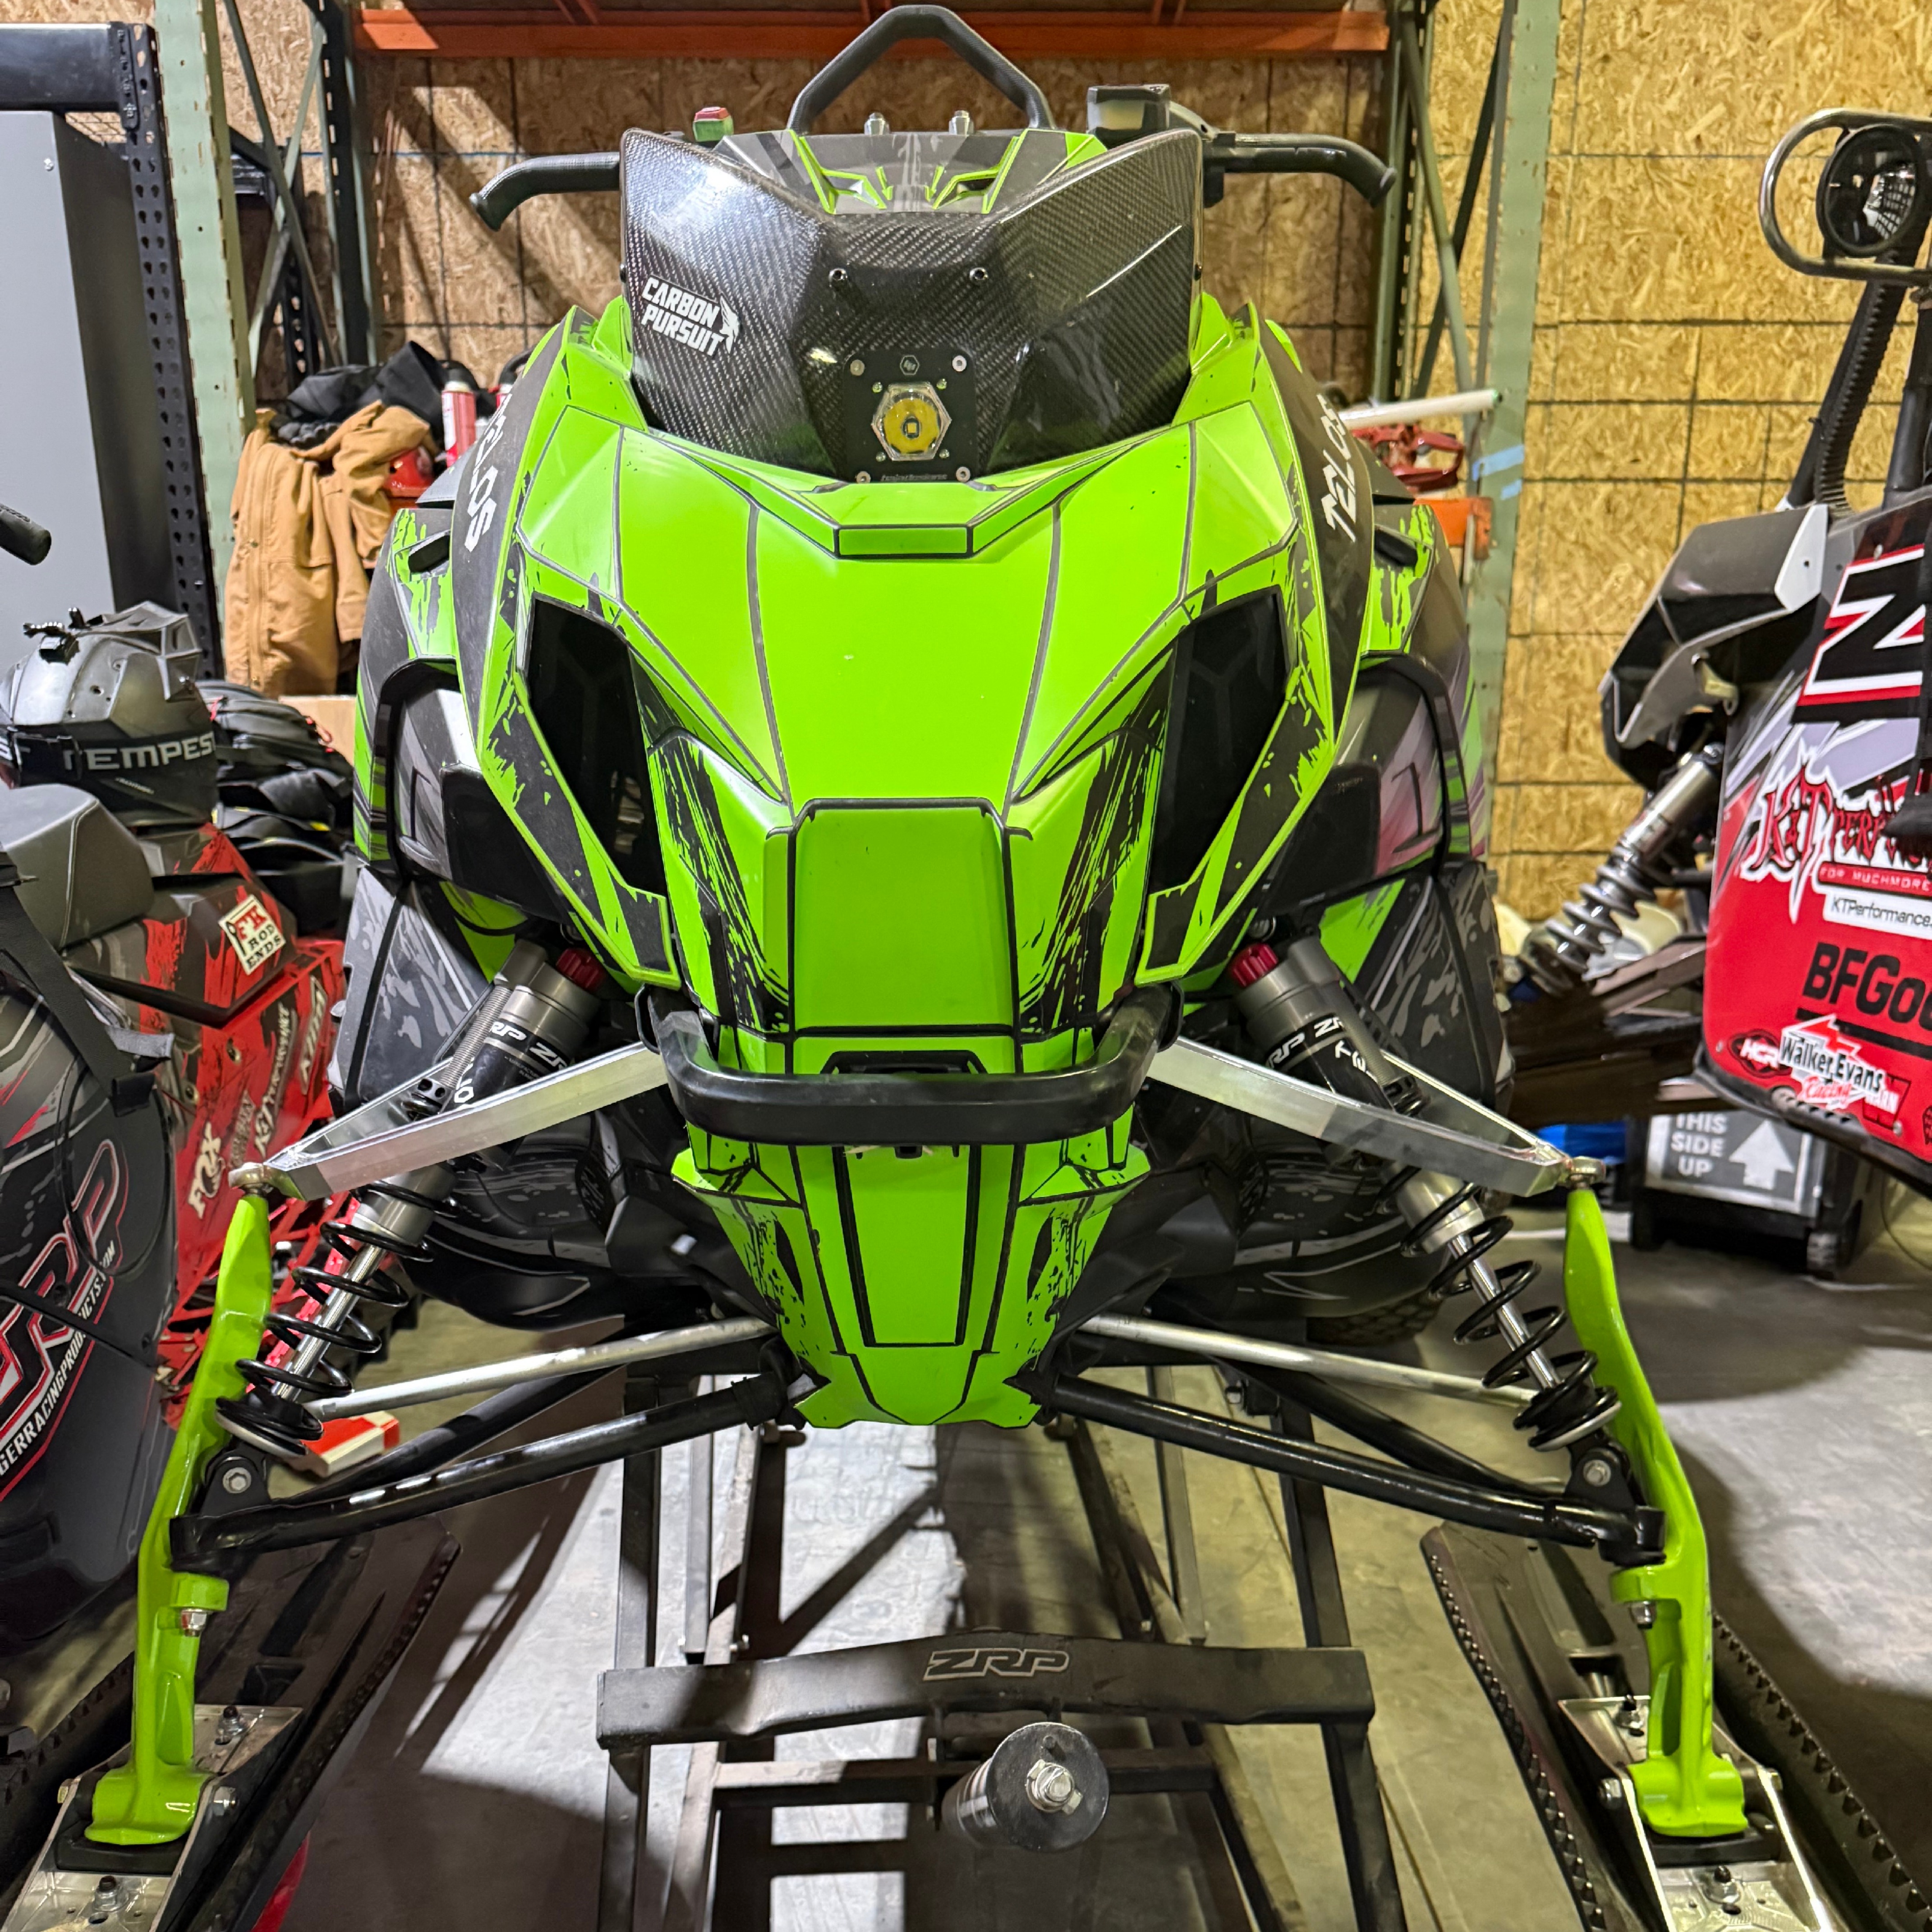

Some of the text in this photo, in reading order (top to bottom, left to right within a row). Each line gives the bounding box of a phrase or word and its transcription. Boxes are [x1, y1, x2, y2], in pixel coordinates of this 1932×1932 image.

[641, 277, 720, 328] CARBON
[641, 304, 724, 356] PURSUIT
[1316, 394, 1356, 543] TELOS
[63, 731, 216, 770] TEMPES
[1820, 868, 1845, 879] FOR
[246, 934, 281, 970] ENDS
[248, 924, 275, 950] ROD
[489, 1021, 527, 1041] RP
[1781, 1036, 1883, 1092] Walker Evans
[1803, 1076, 1852, 1105] Racing
[1671, 1131, 1724, 1158] SIDE
[188, 1121, 226, 1219] FOX
[1678, 1155, 1713, 1178] UP
[922, 1647, 1069, 1681] ZRP
